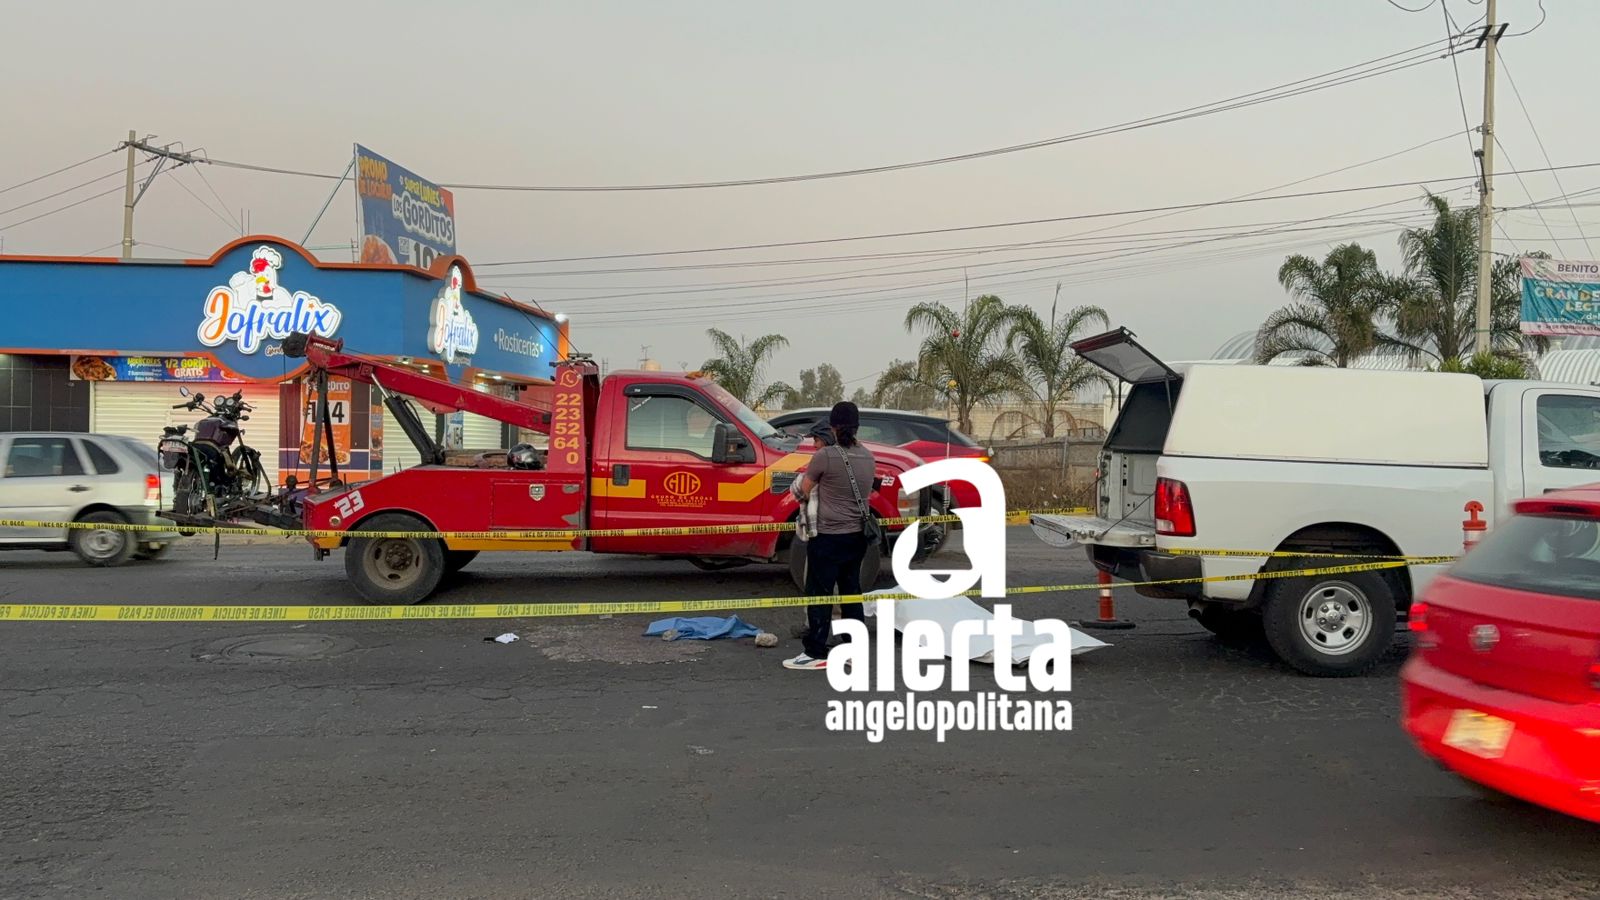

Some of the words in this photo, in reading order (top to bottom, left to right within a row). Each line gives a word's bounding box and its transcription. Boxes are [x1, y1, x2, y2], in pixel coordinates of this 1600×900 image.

[358, 156, 388, 181] PROMO
[420, 181, 440, 207] LUNES
[393, 197, 402, 214] LOS
[402, 194, 453, 242] GORDITOS
[1557, 263, 1599, 274] BENITO
[203, 291, 333, 349] Jofralix
[434, 304, 475, 359] Jofralix
[164, 359, 179, 369] 1/2
[174, 367, 204, 378] GRATIS
[556, 393, 581, 406] 22
[555, 408, 580, 420] 23
[554, 422, 580, 435] 52
[553, 436, 580, 449] 64
[566, 451, 579, 465] 0
[337, 490, 365, 519] 23
[610, 528, 625, 537] PASO
[636, 528, 652, 537] LINEA
[661, 527, 683, 536] POLICIA
[726, 525, 740, 533] PASO
[751, 524, 767, 533] LINEA
[776, 521, 797, 532] POLICIA
